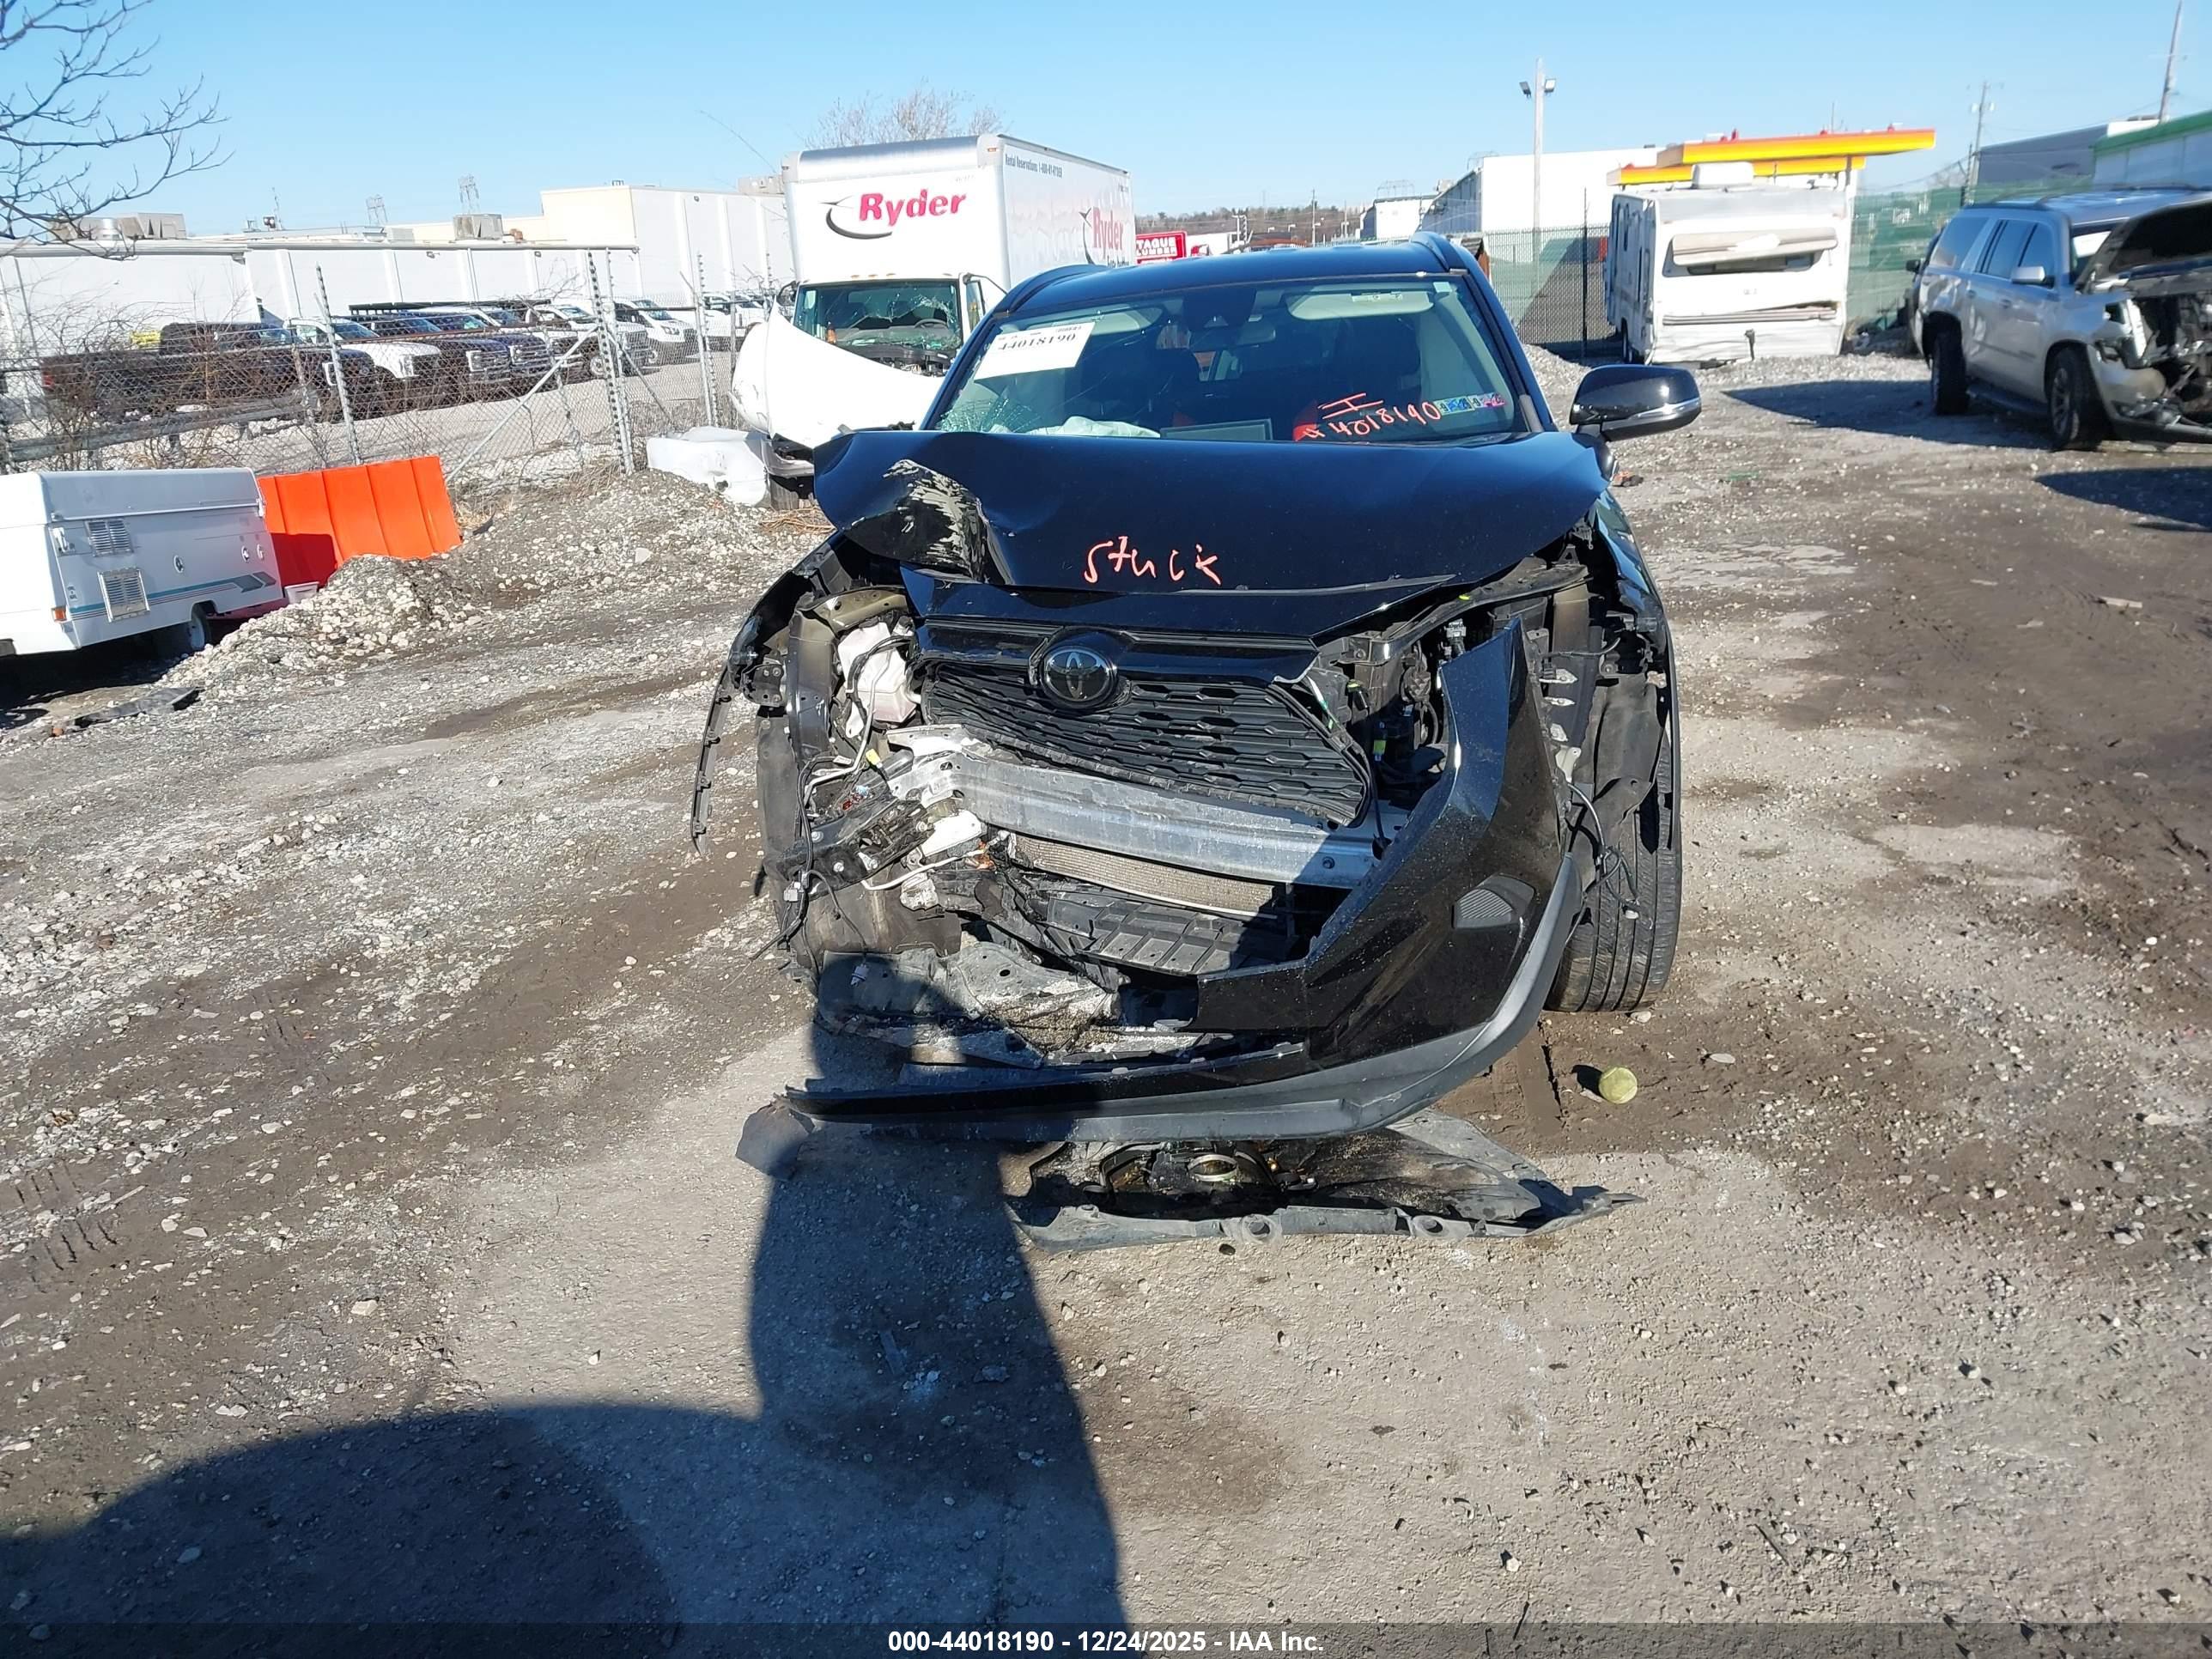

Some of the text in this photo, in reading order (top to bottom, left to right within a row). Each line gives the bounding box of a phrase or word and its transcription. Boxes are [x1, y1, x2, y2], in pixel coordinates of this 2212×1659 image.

[860, 189, 967, 227] Ryder
[1093, 206, 1123, 259] Ryder
[998, 333, 1077, 350] 44018190
